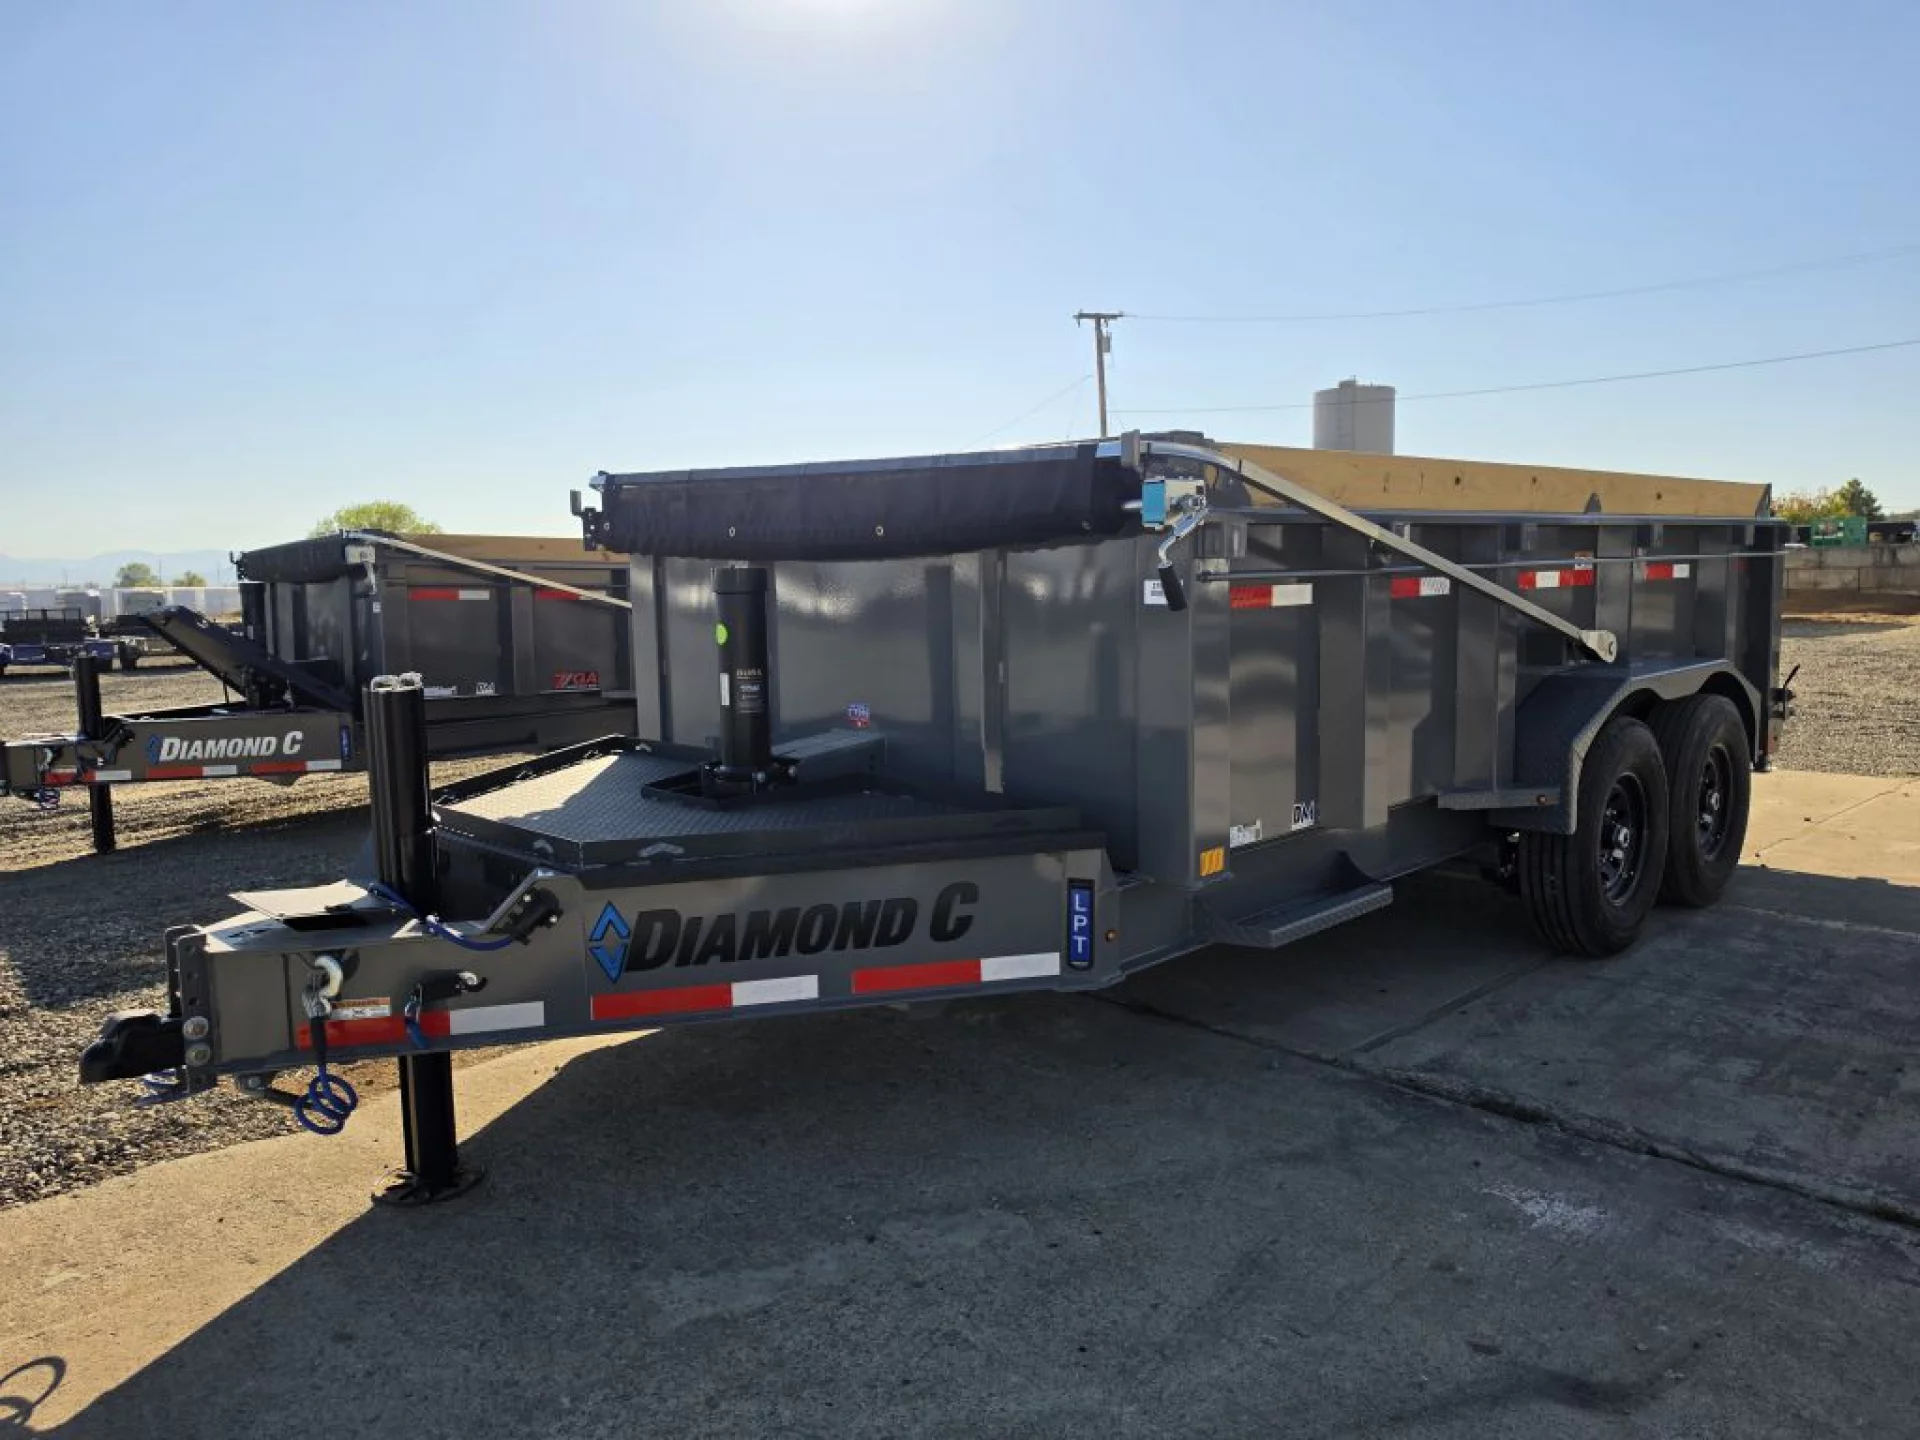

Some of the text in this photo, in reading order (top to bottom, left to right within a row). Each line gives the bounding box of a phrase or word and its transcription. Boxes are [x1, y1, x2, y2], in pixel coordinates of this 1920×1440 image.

[160, 730, 303, 762] DIAMOND C
[624, 881, 980, 973] DIAMOND C
